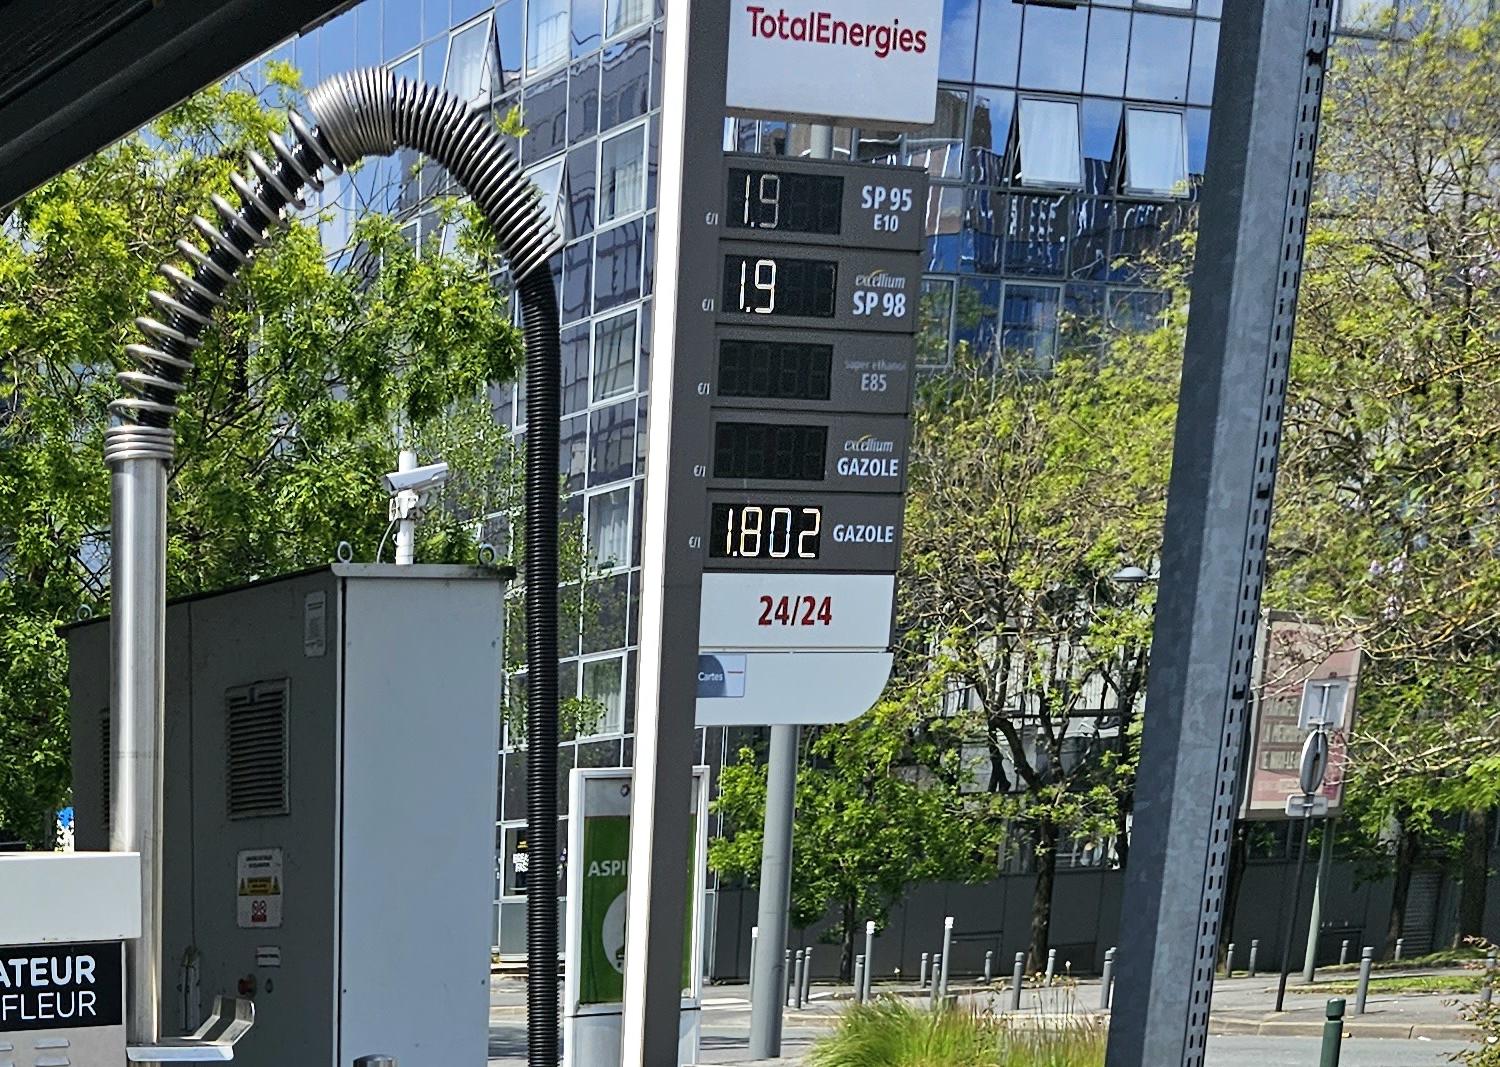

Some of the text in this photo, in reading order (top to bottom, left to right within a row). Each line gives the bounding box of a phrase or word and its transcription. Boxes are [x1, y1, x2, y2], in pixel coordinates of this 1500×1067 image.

[746, 6, 927, 59] TotalEnergies
[861, 185, 912, 212] SP 95
[873, 214, 898, 232] E10
[855, 272, 905, 289] excellium
[852, 291, 905, 317] SP 98
[861, 374, 887, 391] E85
[845, 437, 893, 454] excellium
[837, 458, 898, 477] GAZOLE
[727, 506, 821, 558] 1.802
[833, 525, 894, 544] GAZOLE
[758, 596, 832, 627] 24/24
[698, 672, 723, 681] Cartes
[588, 860, 626, 877] ASPI
